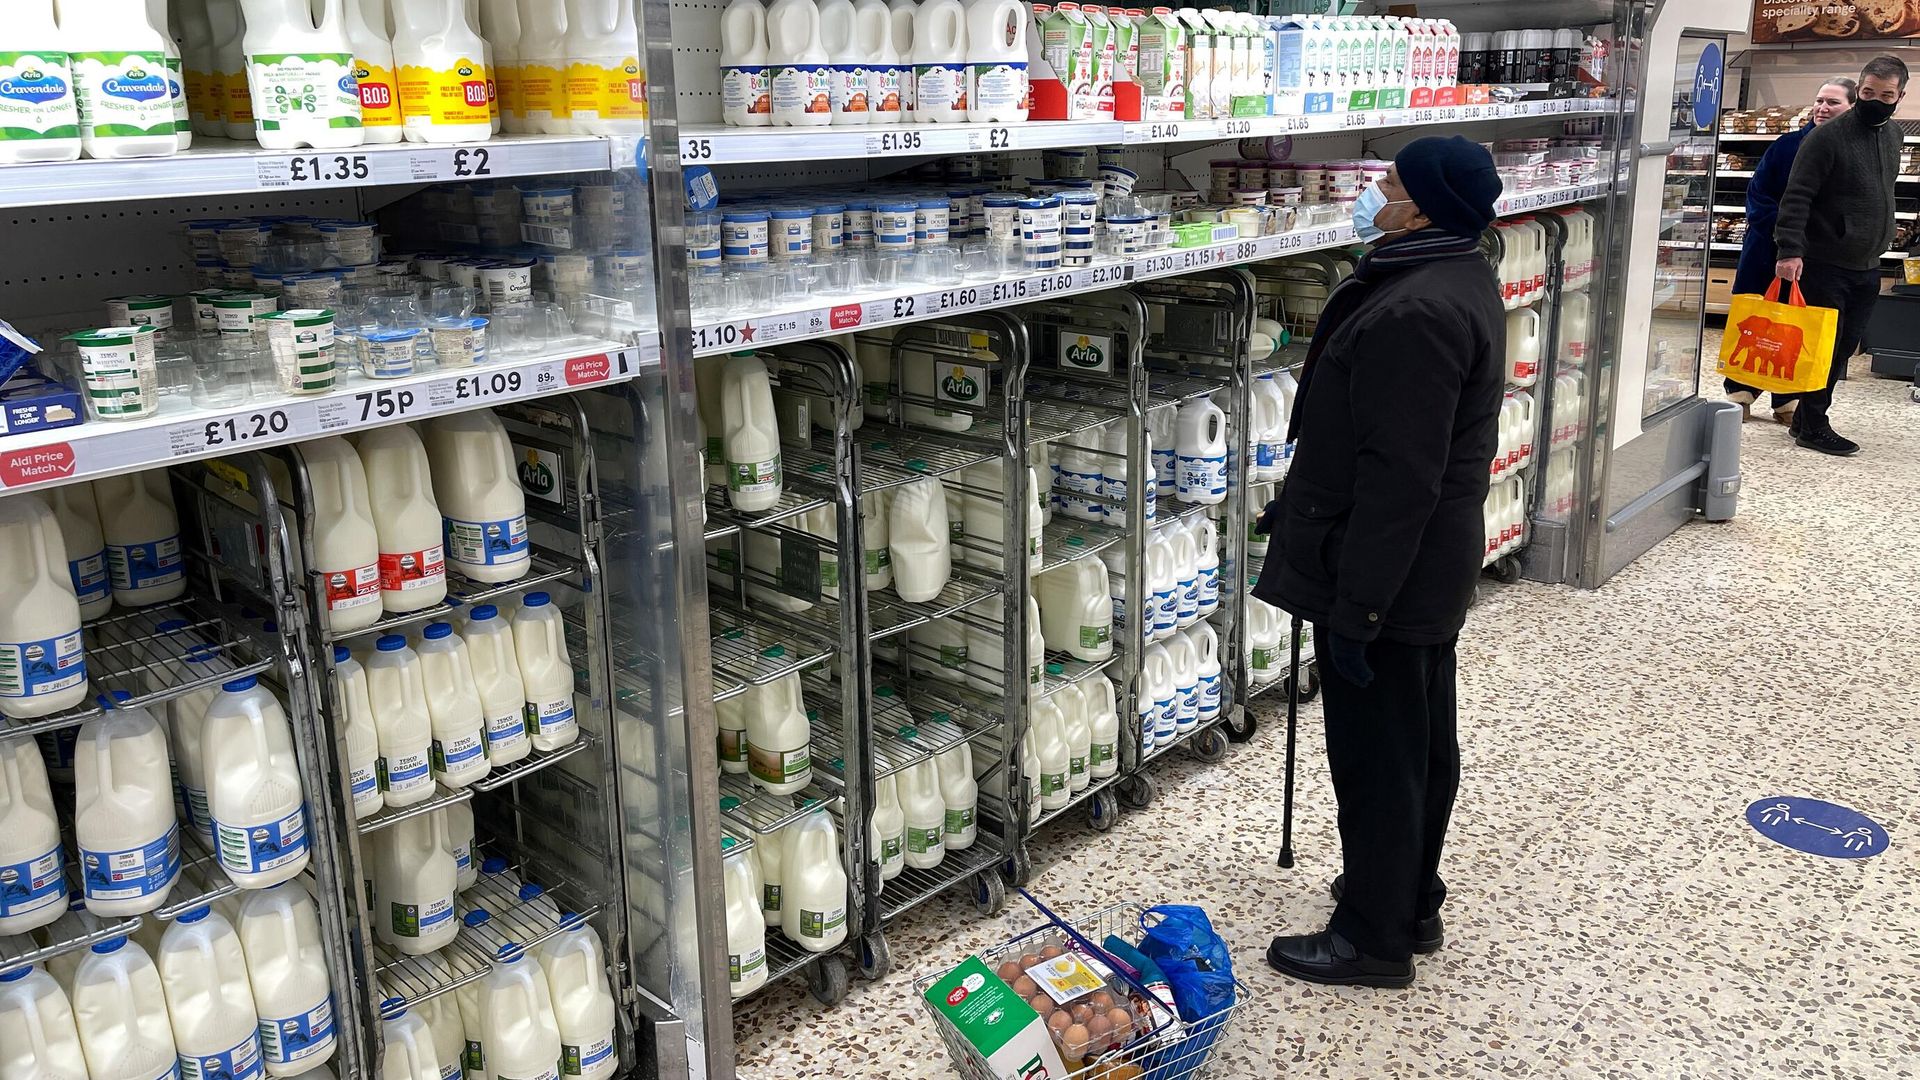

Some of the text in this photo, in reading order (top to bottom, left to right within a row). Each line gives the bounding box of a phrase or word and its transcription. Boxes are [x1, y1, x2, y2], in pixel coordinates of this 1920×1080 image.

[1762, 5, 1856, 19] speciality range
[23, 71, 41, 79] Arla
[0, 82, 65, 94] Cravendale
[106, 80, 165, 92] Cravendale
[0, 104, 31, 113] RESHER
[101, 100, 136, 111] FRESHER
[1487, 106, 1499, 117] £1.8
[1415, 110, 1432, 121] £1.65
[1439, 108, 1456, 119] £1.80
[1464, 107, 1480, 118] £1.80
[1287, 117, 1309, 130] £1.65
[1346, 114, 1366, 126] £1.65
[1151, 124, 1179, 138] £1.40
[1226, 121, 1250, 134] £1.20
[882, 131, 921, 151] £1.95
[990, 128, 1009, 148] £2
[682, 140, 711, 159] .35
[290, 156, 369, 181] £1.35
[453, 148, 491, 176] £2
[1279, 235, 1301, 249] £2.05
[1316, 230, 1337, 244] £1.10
[1237, 243, 1257, 259] 88p
[1146, 256, 1173, 273] £1.30
[1184, 250, 1210, 267] £1.15
[1092, 266, 1121, 283] £2.10
[1040, 274, 1072, 293] £1.60
[992, 281, 1026, 301] £1.15
[940, 289, 977, 309] £1.60
[893, 296, 914, 318] £2
[778, 321, 796, 331] £1.15
[810, 318, 822, 327] 89p
[838, 316, 853, 324] Match
[691, 324, 736, 349] £1.10
[1071, 347, 1097, 363] Arla
[571, 360, 603, 372] Aldi Price
[537, 372, 555, 384] 89p
[577, 369, 599, 379] Match
[455, 371, 522, 399] £1.09
[946, 379, 973, 396] Arla
[12, 406, 38, 415] FRESHER
[355, 389, 414, 422] 75p
[204, 410, 289, 445] £1.20
[10, 452, 64, 468] Aldi Price
[21, 463, 56, 477] Match
[522, 468, 549, 488] Arla
[544, 704, 569, 715] ORGANIC
[548, 700, 565, 709] TESCO
[491, 719, 519, 731] ORGANIC
[496, 715, 513, 724] TESCO
[448, 741, 477, 754] ORGANIC
[453, 737, 471, 747] TESCO
[393, 760, 423, 772] ORGANIC
[399, 755, 417, 765] TESCO
[350, 769, 364, 777] ESCO
[350, 773, 371, 784] GANIC
[425, 903, 450, 916] ORGANIC
[430, 899, 446, 909] TESCO
[591, 1039, 605, 1049] TESCO
